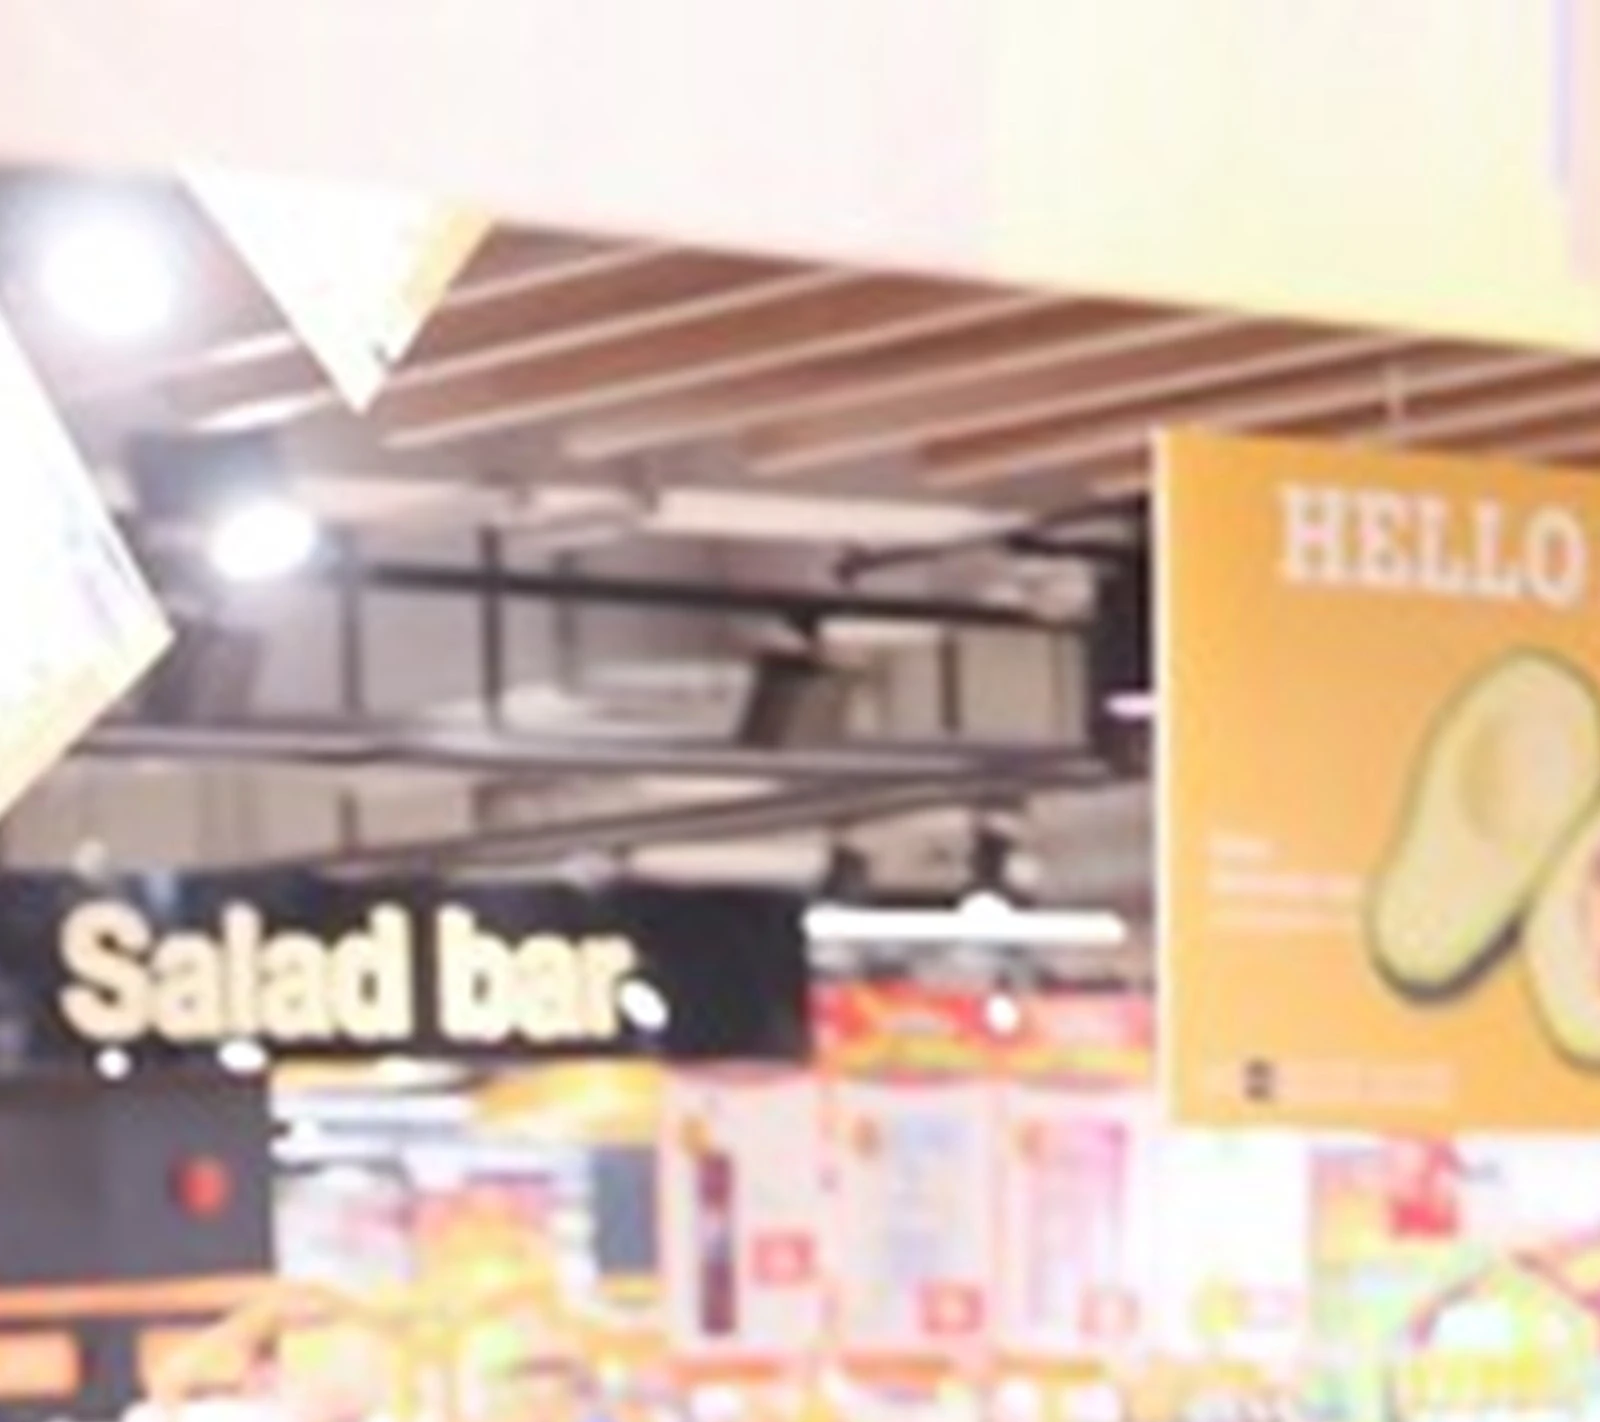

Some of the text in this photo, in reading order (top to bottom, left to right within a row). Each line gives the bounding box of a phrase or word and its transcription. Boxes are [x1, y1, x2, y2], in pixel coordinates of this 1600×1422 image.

[1279, 482, 1588, 610] HELLO
[58, 899, 637, 1041] Salad bar
